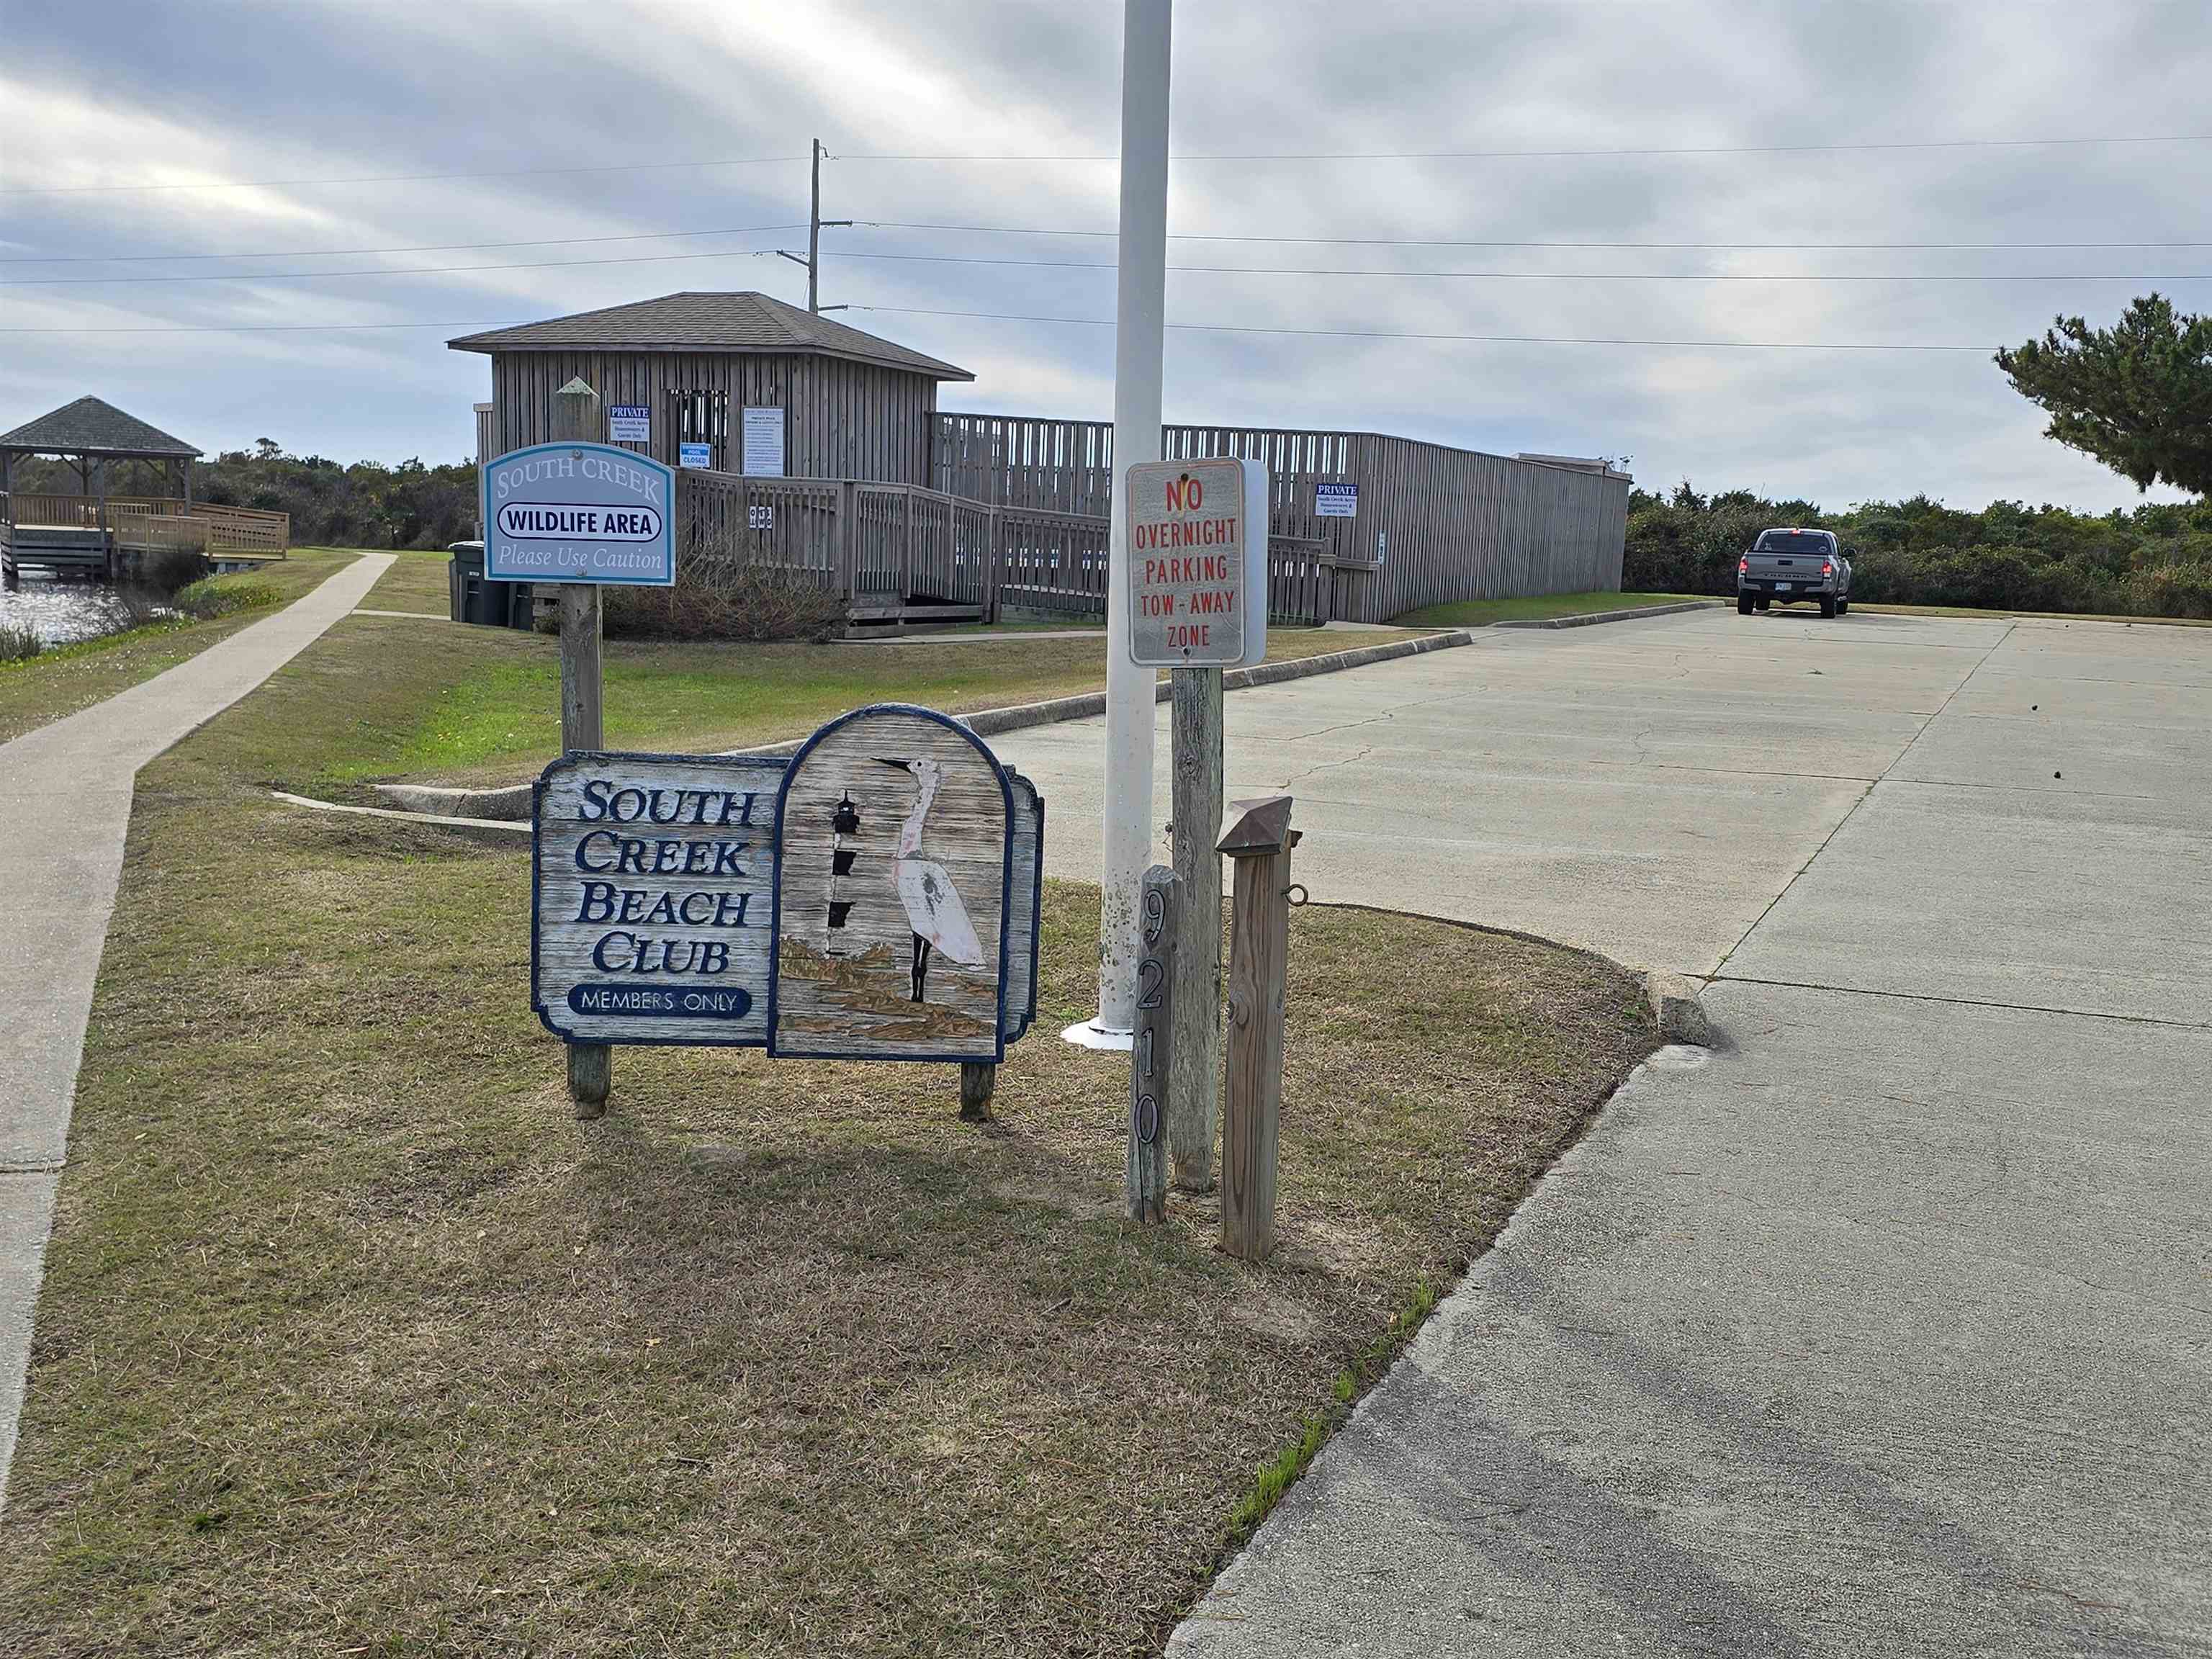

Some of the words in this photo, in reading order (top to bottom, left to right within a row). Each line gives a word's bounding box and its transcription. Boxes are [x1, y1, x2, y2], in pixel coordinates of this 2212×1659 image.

[611, 406, 649, 418] PRIVATE
[498, 457, 575, 499] SOUTH
[582, 458, 660, 505] CREEK
[1165, 478, 1203, 512] NO
[1318, 485, 1357, 495] PRIVATE
[506, 510, 597, 533] WILDLIFE
[603, 513, 652, 535] AREA
[1136, 518, 1236, 550] OVERNIGHT
[498, 544, 552, 565] Please
[558, 547, 588, 567] Use
[593, 548, 662, 570] Caution
[1145, 555, 1228, 585] PARKING
[1168, 625, 1210, 647] ZONE
[578, 780, 757, 825] SOUTH
[575, 830, 753, 876] CREEK
[574, 881, 753, 927] BEACH
[592, 930, 731, 974] CLUB
[581, 992, 674, 1010] MEMBERS
[683, 992, 738, 1012] ONLY
